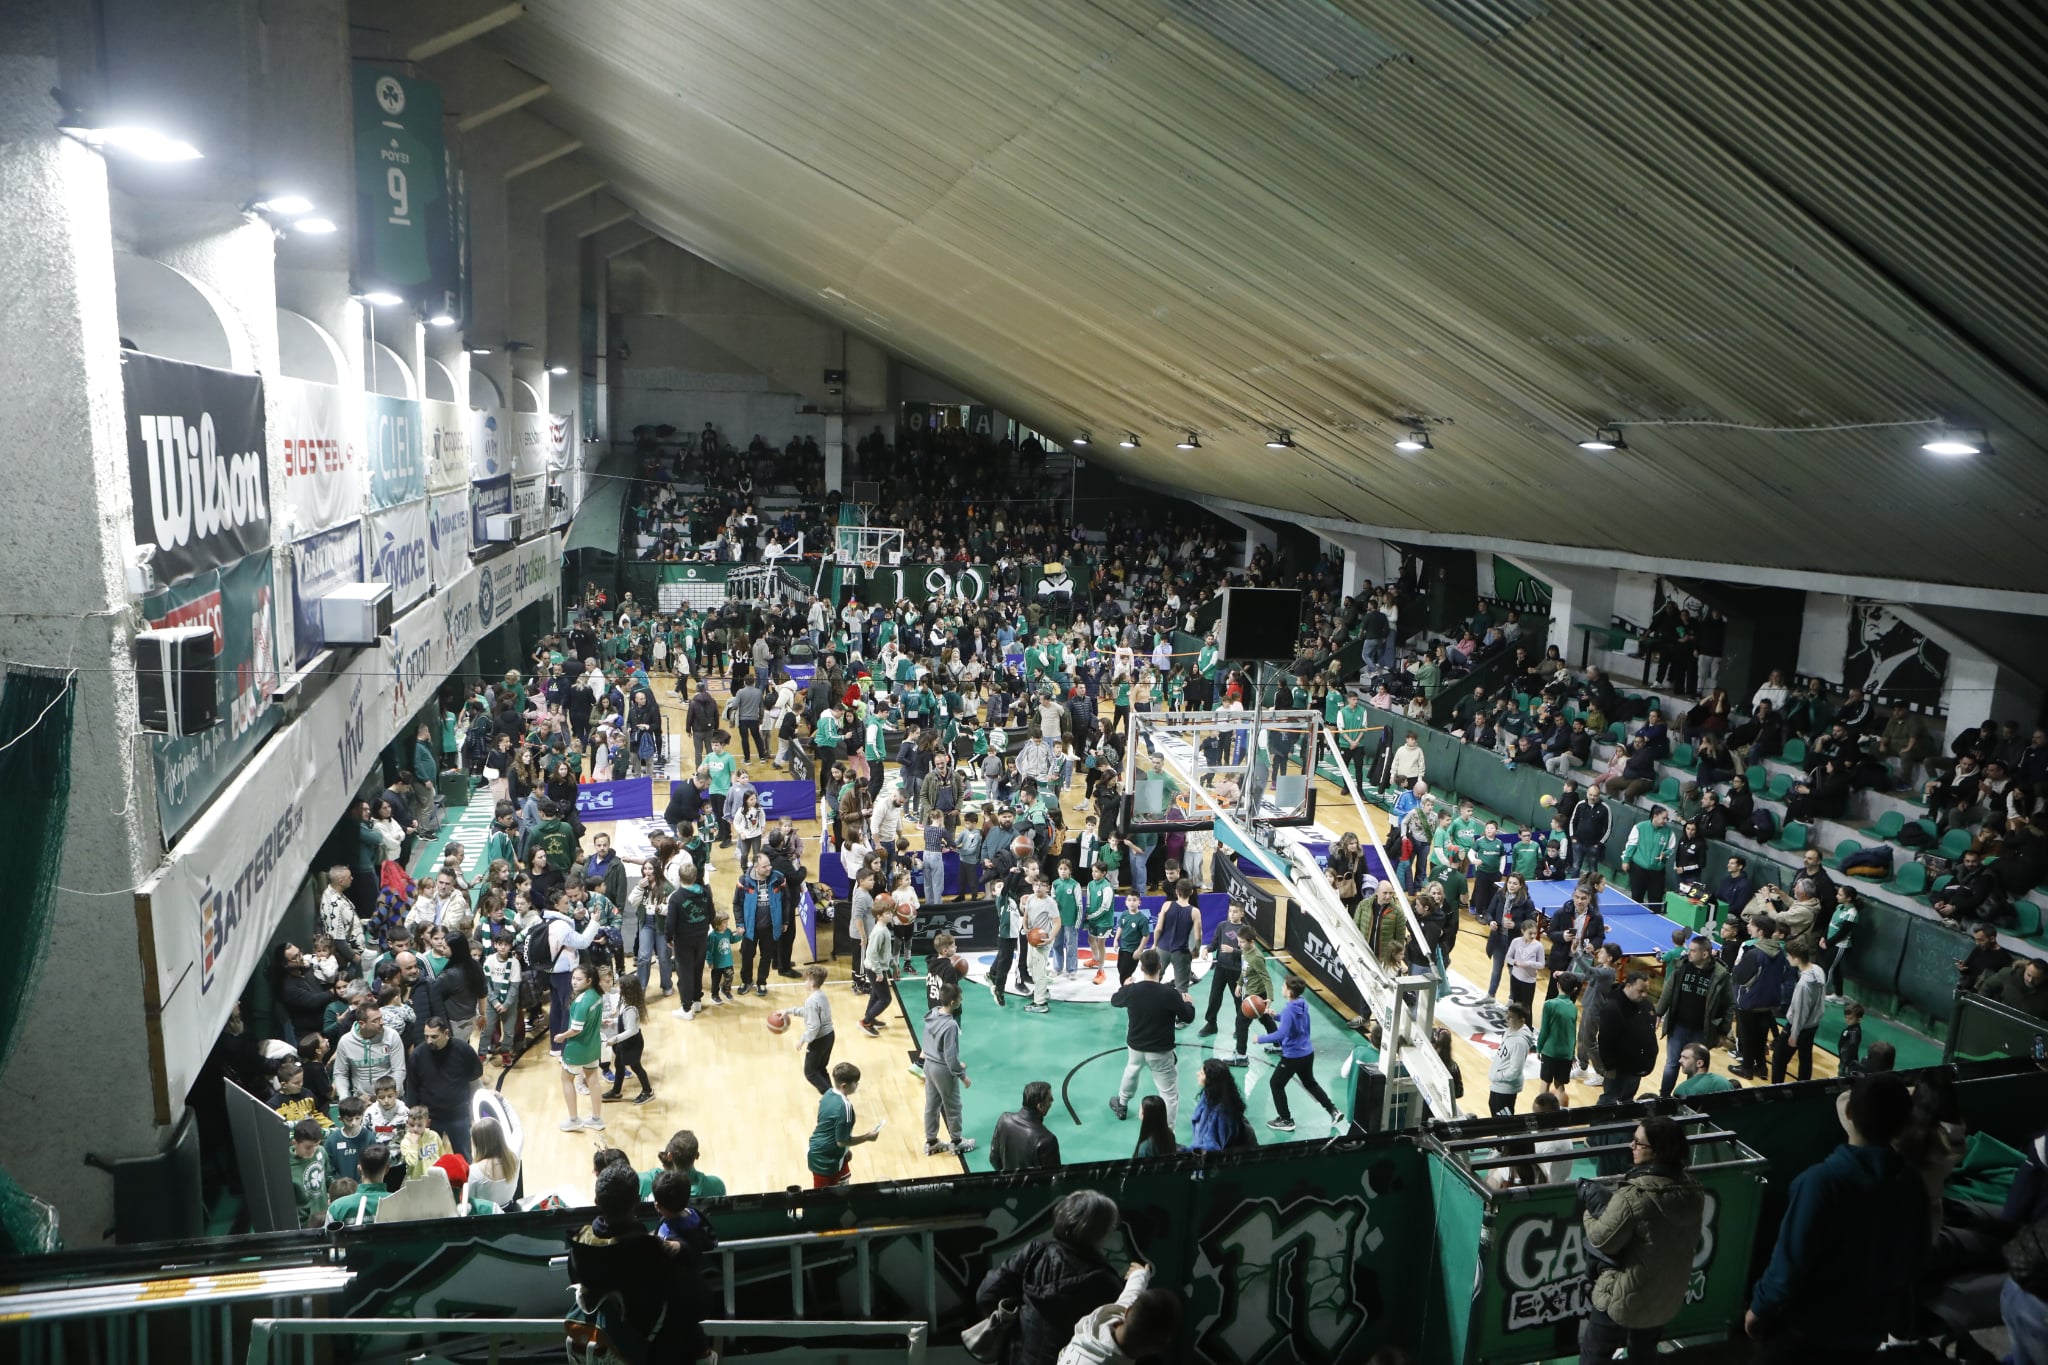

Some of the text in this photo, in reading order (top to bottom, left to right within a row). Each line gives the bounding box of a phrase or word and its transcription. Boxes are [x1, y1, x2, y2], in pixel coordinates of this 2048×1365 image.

[387, 166, 409, 216] 9
[140, 412, 266, 552] Wilson
[284, 439, 344, 477] BIOSTEEL
[1304, 931, 1345, 984] STAG
